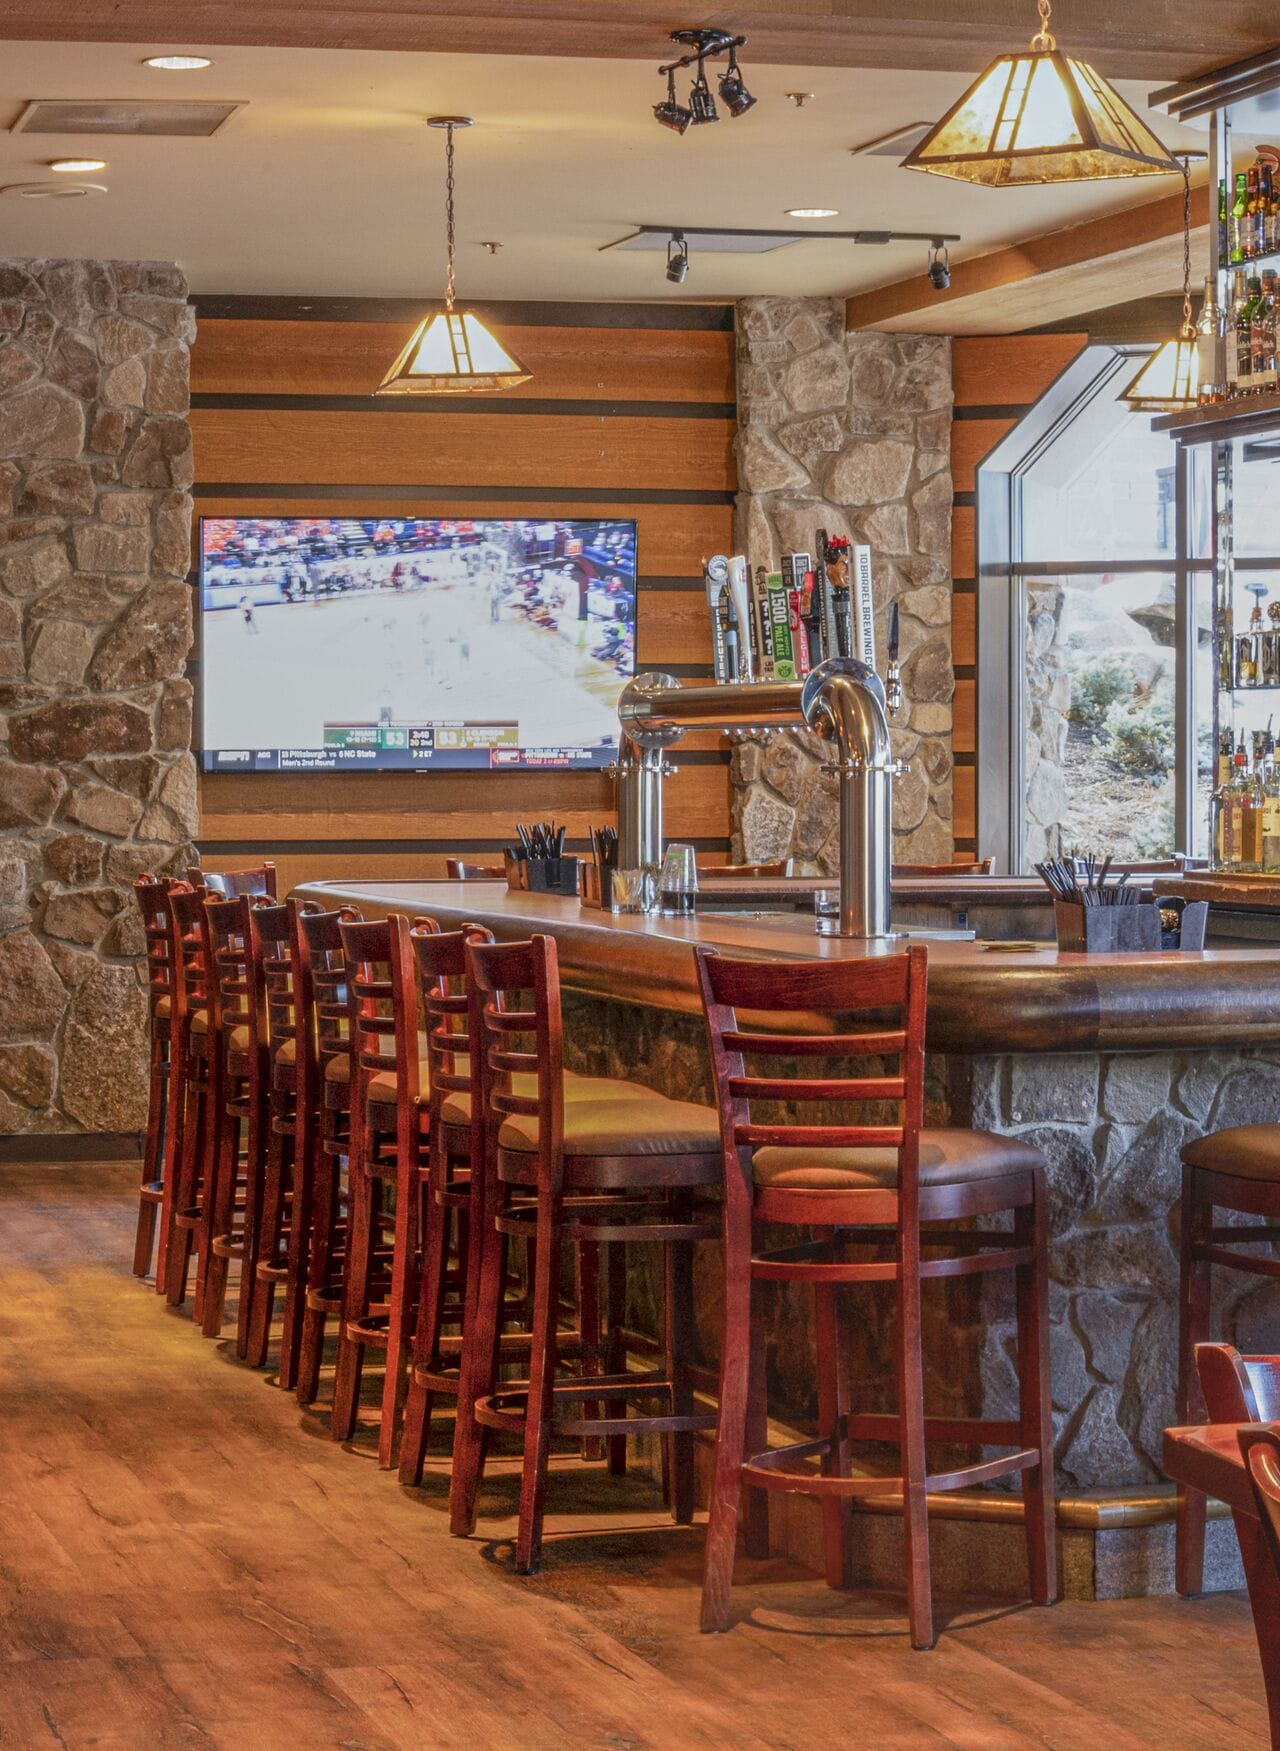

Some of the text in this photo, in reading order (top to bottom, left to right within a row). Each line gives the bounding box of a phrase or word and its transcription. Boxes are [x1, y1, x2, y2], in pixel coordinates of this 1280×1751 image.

[860, 567, 870, 605] BARREL
[771, 591, 787, 624] 1500
[774, 625, 785, 656] PALE ALE
[863, 607, 873, 655] BREWING
[289, 751, 327, 760] Pittsburgh
[357, 750, 377, 758] State
[314, 759, 336, 767] Round
